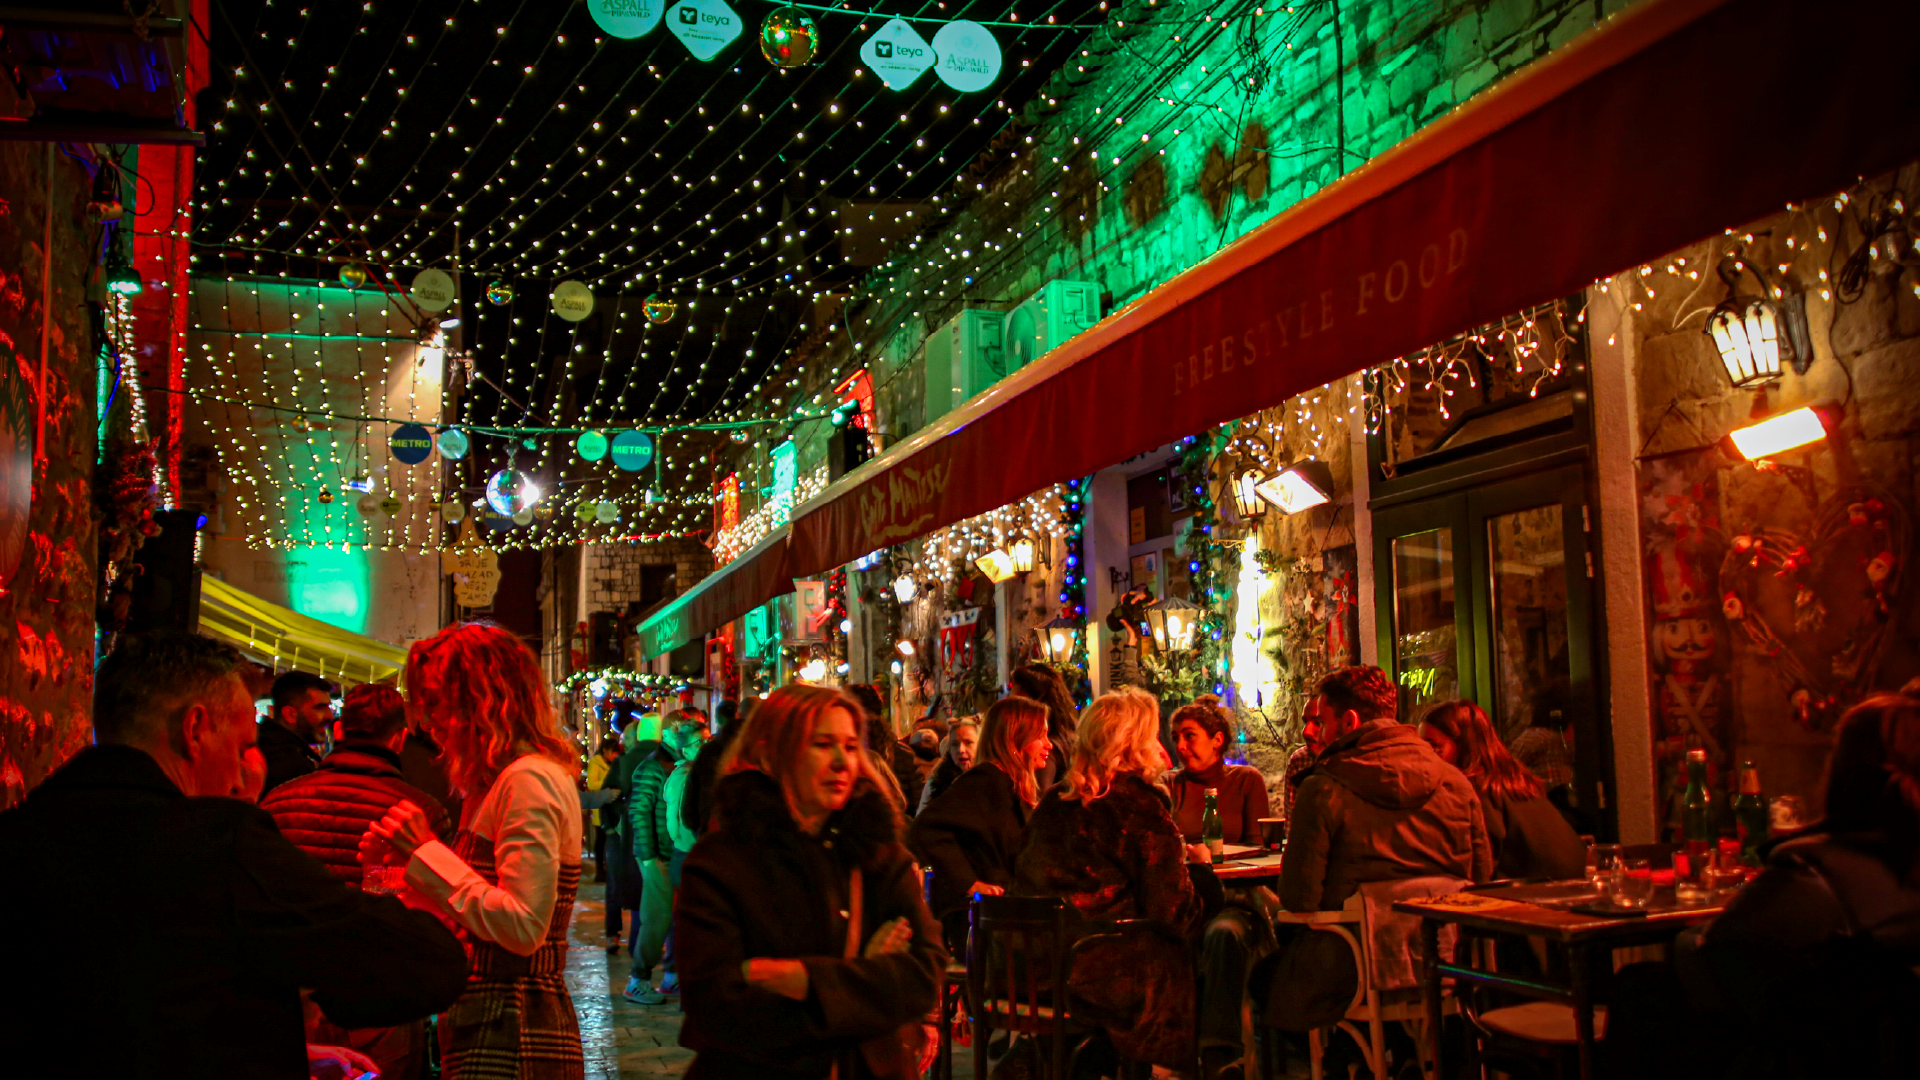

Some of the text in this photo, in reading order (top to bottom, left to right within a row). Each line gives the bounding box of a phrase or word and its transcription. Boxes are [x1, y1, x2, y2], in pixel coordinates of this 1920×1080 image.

[701, 12, 730, 26] teya
[896, 45, 923, 58] teya
[944, 53, 990, 69] ASPALL
[1173, 228, 1468, 396] FREESTYLE FOOD
[391, 439, 431, 448] METRO
[612, 445, 651, 455] METRO
